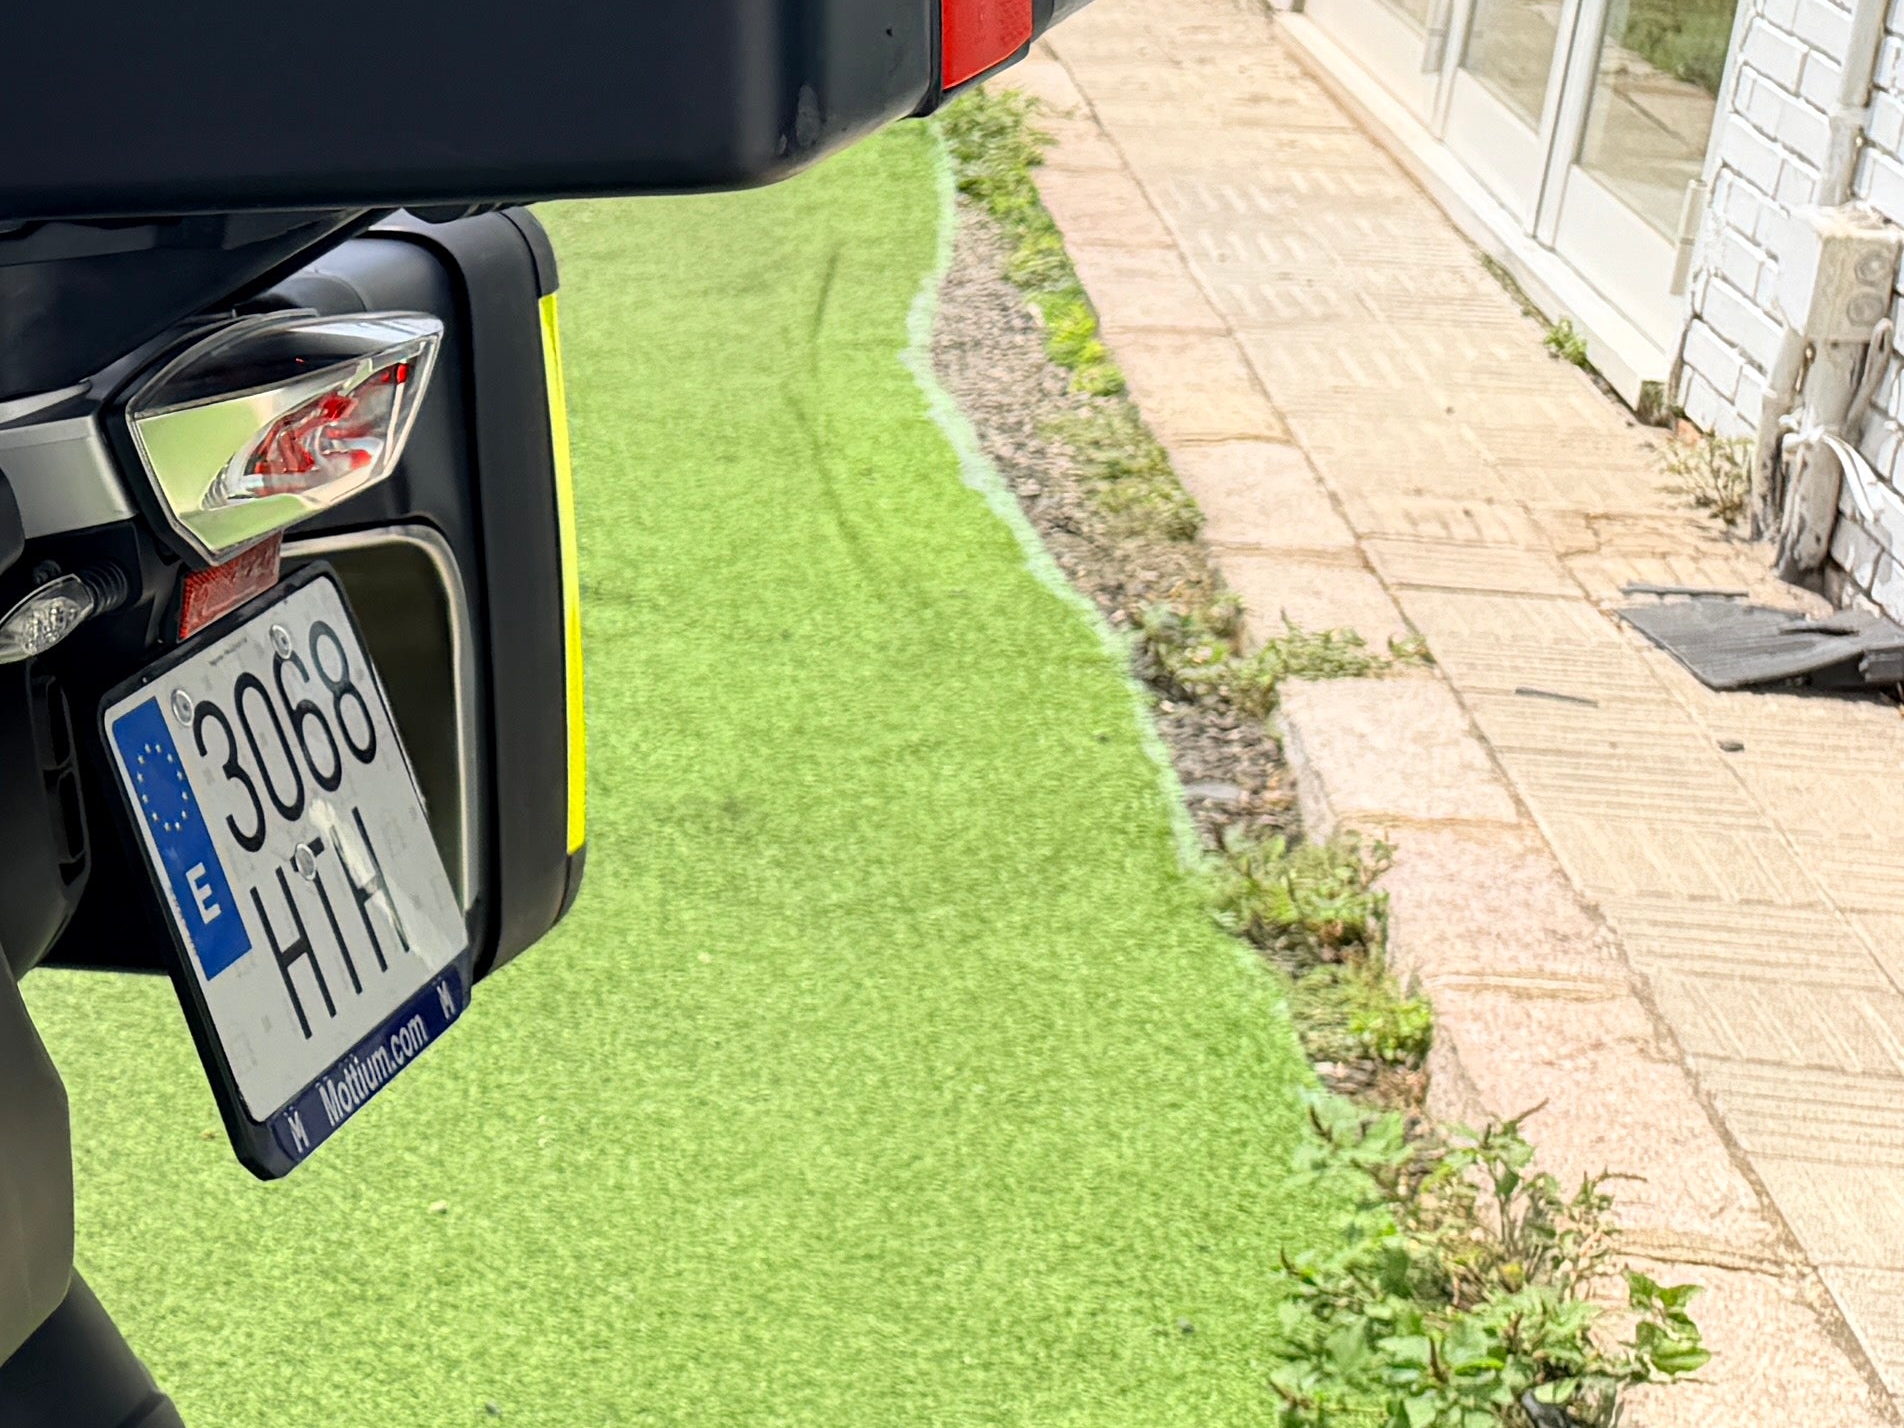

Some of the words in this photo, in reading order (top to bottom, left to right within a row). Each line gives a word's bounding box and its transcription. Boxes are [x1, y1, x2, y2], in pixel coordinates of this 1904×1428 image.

[192, 620, 377, 853] 3068
[185, 861, 222, 924] E
[249, 806, 410, 1040] HTH
[321, 1011, 428, 1127] Mottium.com
